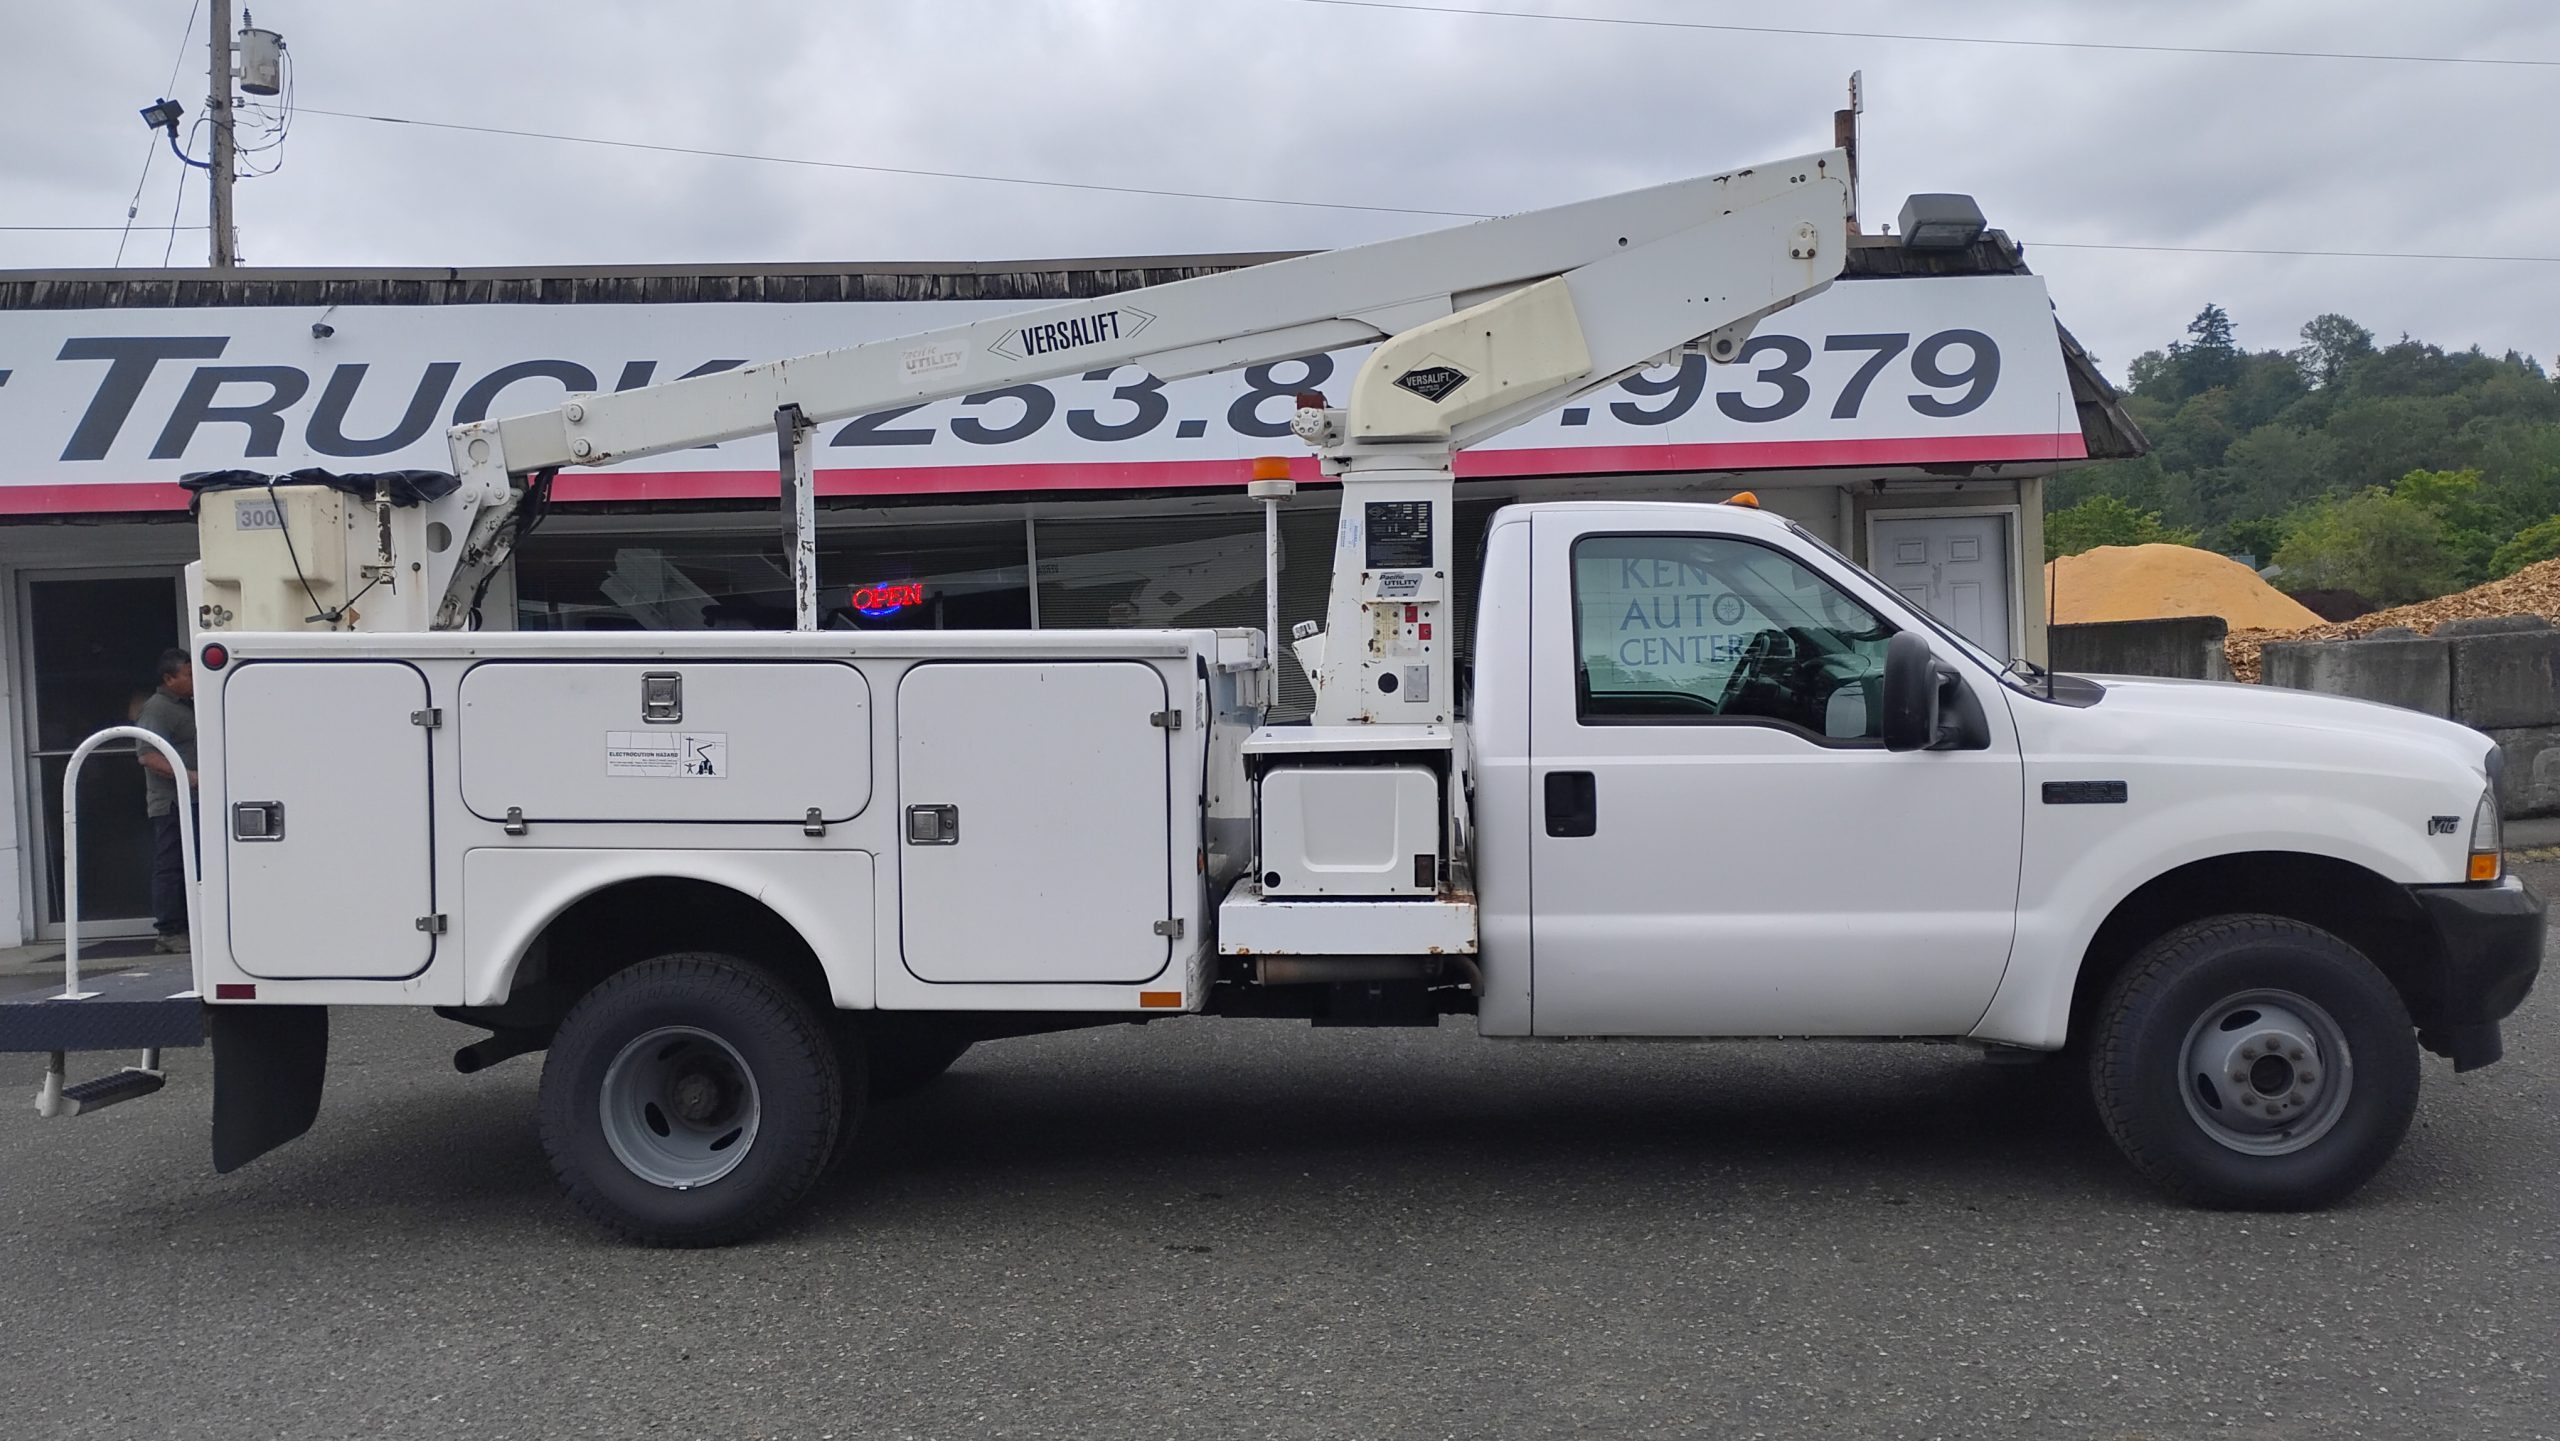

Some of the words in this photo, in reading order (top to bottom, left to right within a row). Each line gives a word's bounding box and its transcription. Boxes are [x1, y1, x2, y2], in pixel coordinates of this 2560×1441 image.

[1020, 311, 1120, 356] VERSALIFT
[905, 351, 962, 370] UTILITY
[1406, 372, 1450, 387] VERSALIFT
[56, 336, 750, 461] TRUC
[852, 583, 923, 609] OPEN
[1619, 591, 1746, 631] AUTO
[1619, 634, 1744, 667] CENTER
[2427, 820, 2458, 836] V10
